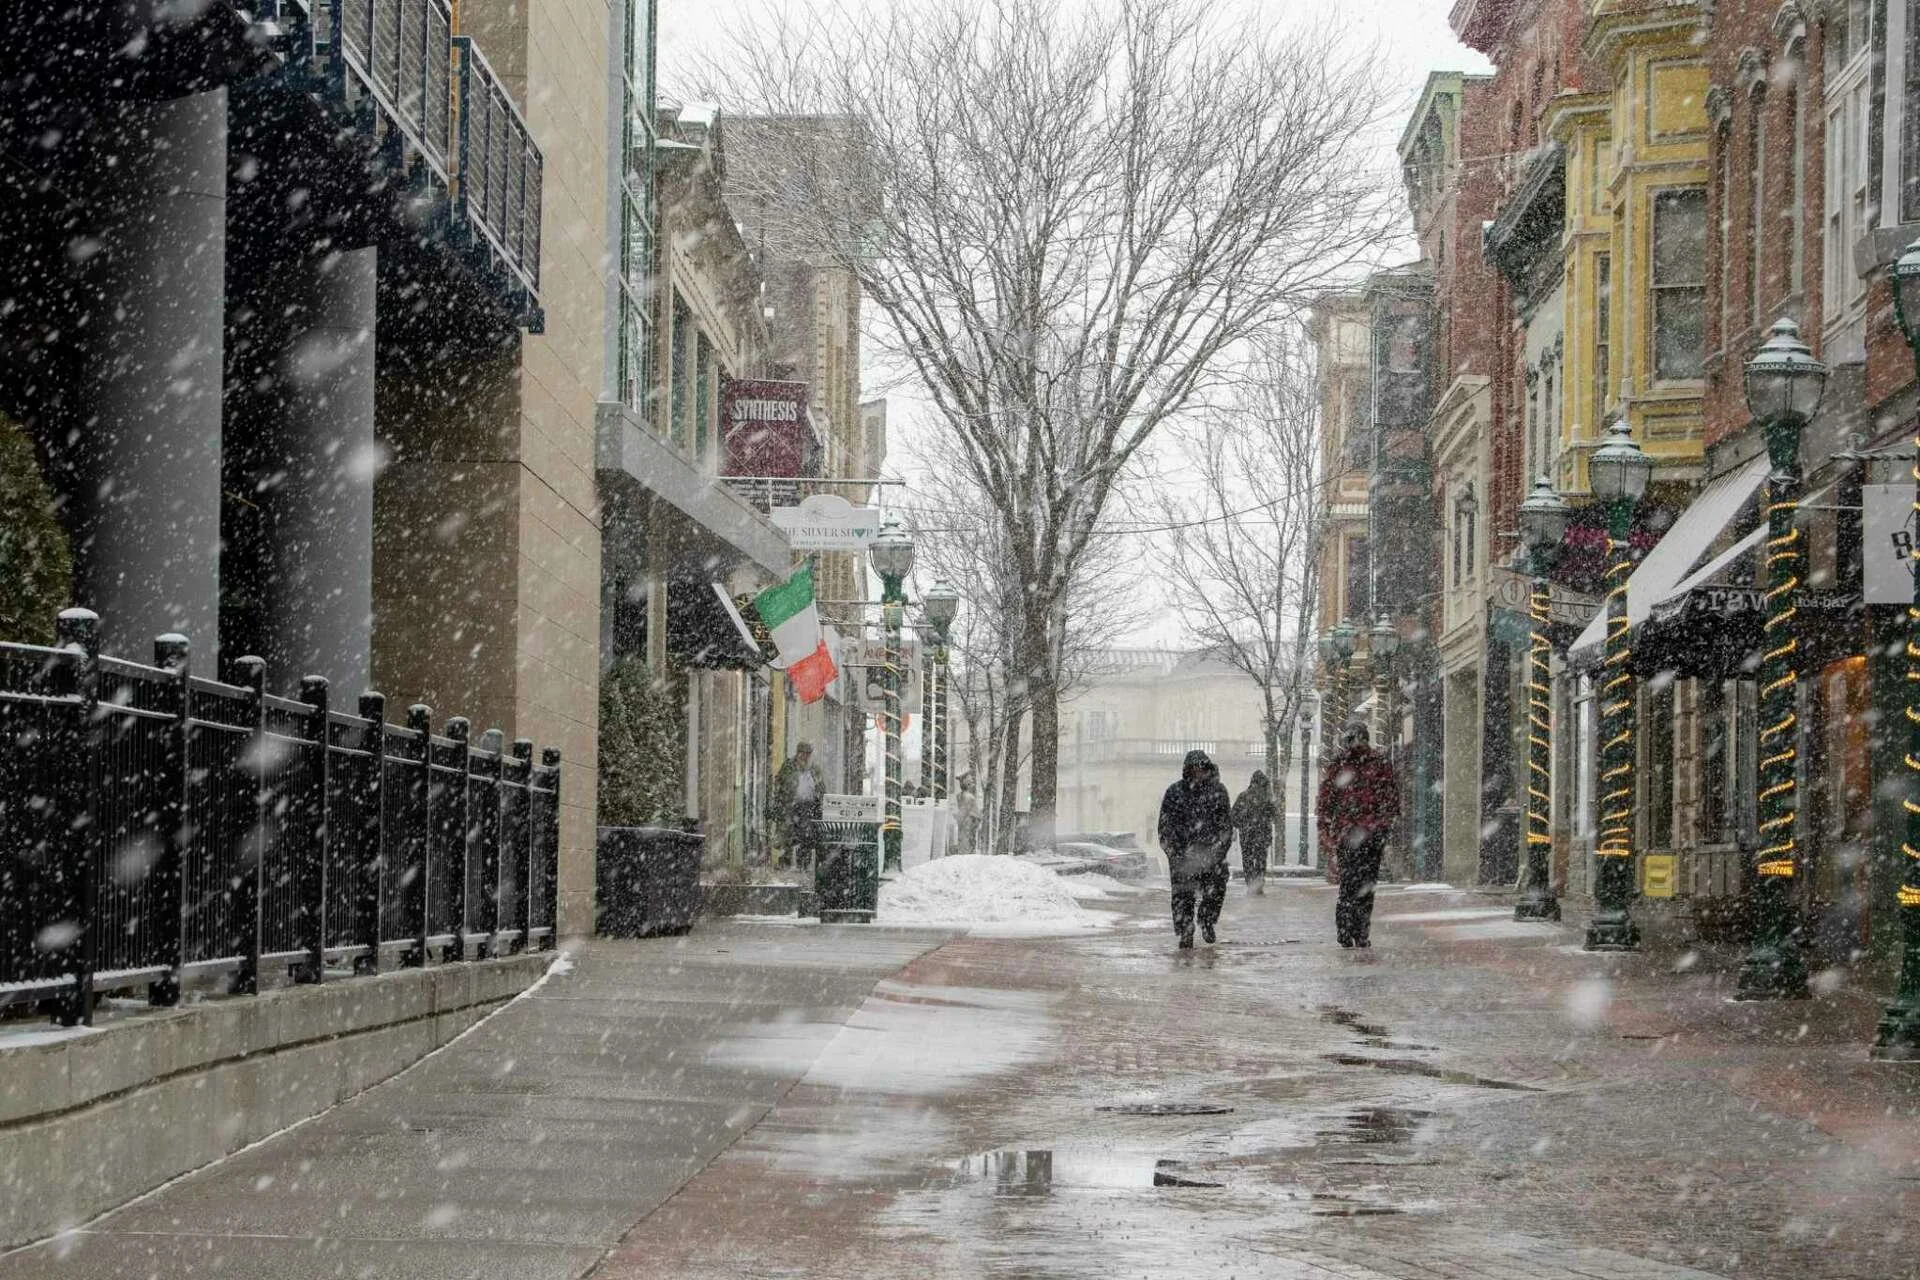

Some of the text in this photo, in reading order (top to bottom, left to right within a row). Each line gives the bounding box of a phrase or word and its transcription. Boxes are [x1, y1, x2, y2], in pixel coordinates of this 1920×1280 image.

[734, 399, 798, 421] SYNTHESIS
[802, 527, 838, 538] SILVER
[840, 527, 874, 538] SHP
[1708, 589, 1769, 612] raw
